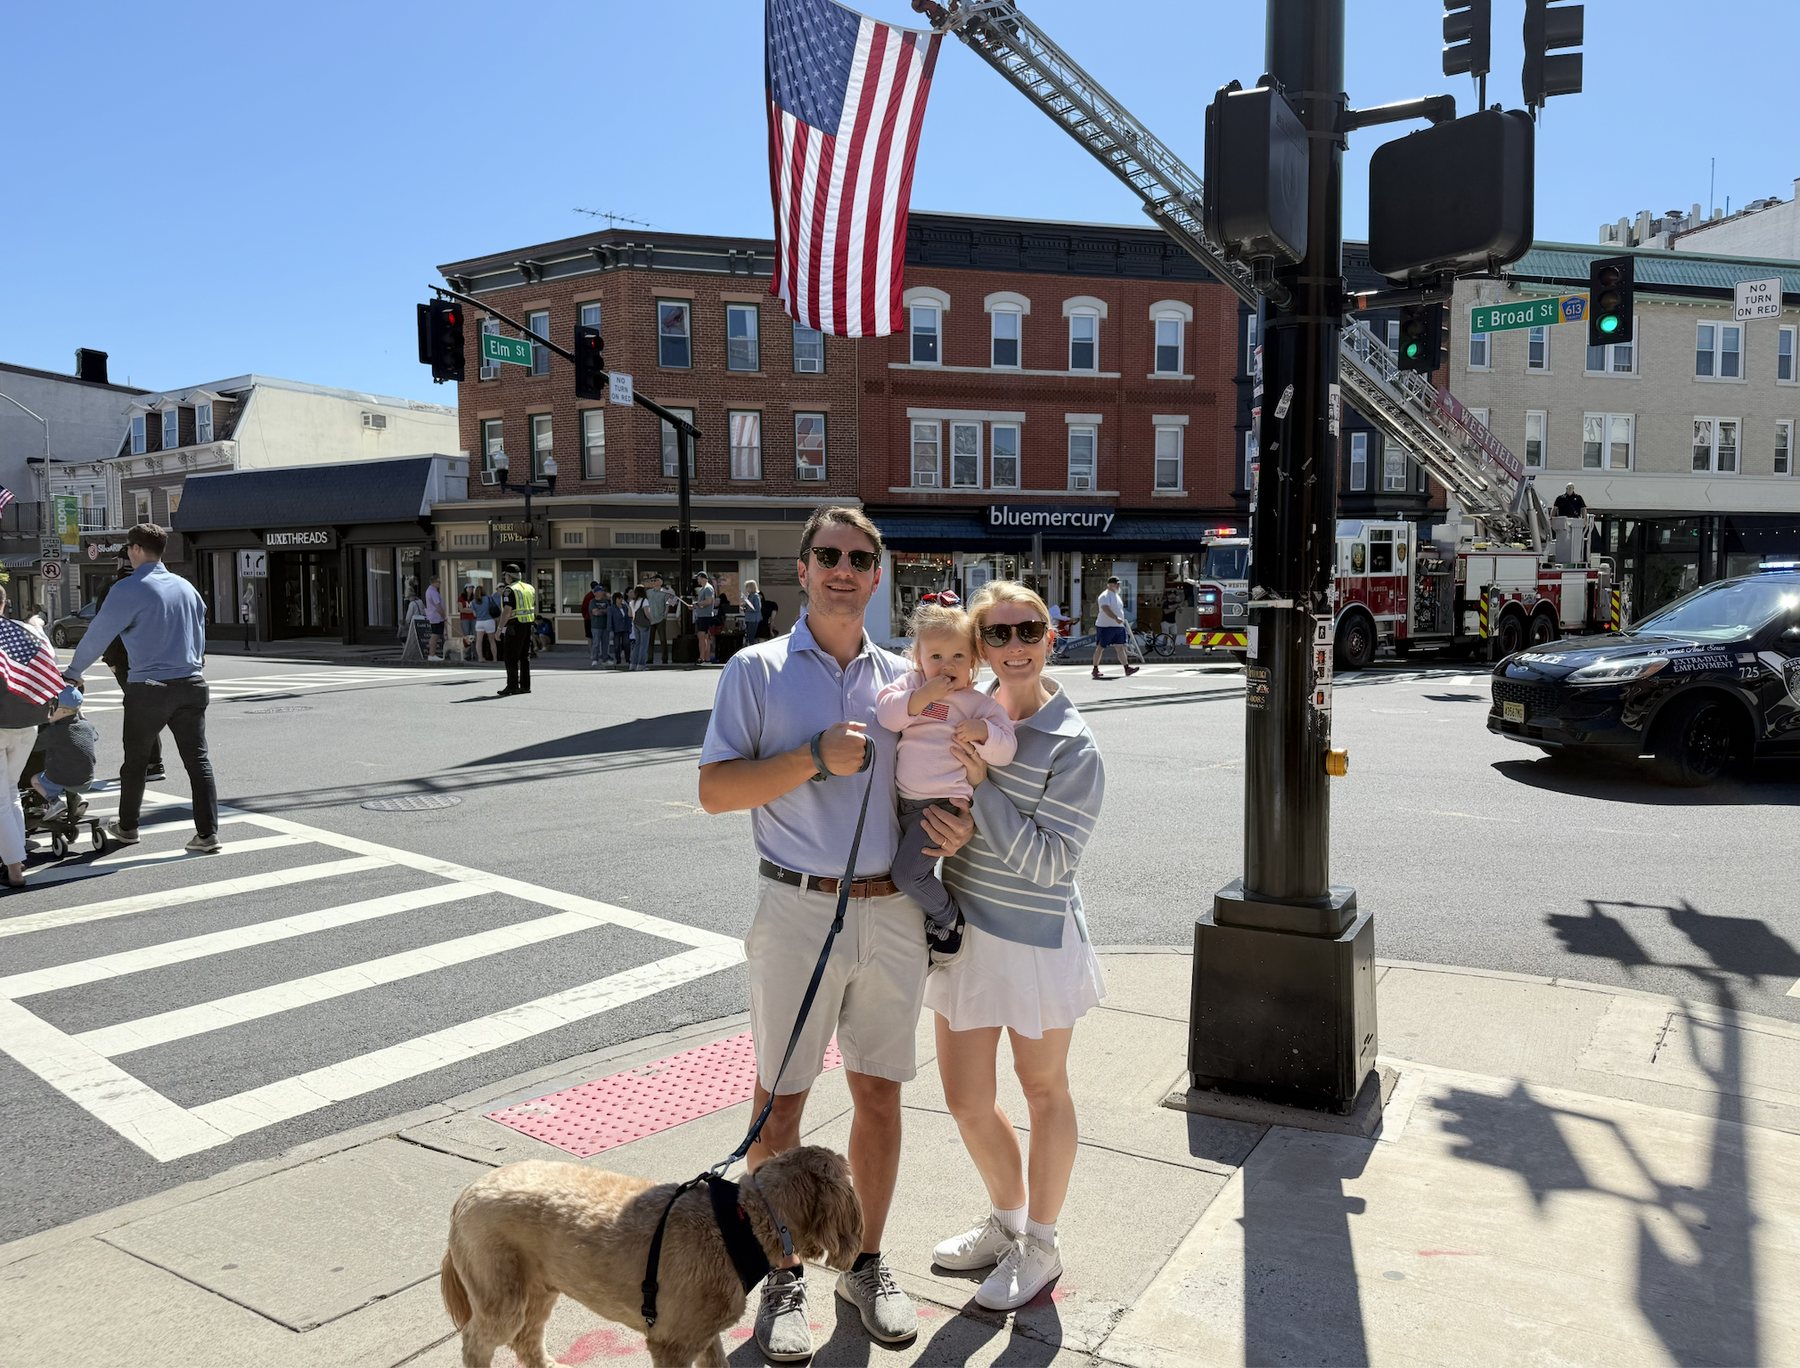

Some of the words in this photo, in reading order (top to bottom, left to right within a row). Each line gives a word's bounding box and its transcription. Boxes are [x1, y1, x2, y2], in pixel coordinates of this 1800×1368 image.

[1750, 283, 1767, 293] NO
[1745, 294, 1772, 304] TURN
[1477, 316, 1484, 328] E
[1491, 307, 1534, 327] Broad
[1540, 304, 1553, 317] St
[1565, 303, 1582, 316] 613
[1737, 307, 1752, 317] ON
[1757, 304, 1778, 315] RED
[490, 340, 510, 358] Elm
[516, 345, 525, 357] St
[614, 384, 629, 393] TURN
[621, 394, 632, 402] RED
[1461, 408, 1519, 473] WESTFIELD
[57, 499, 67, 534] BLOOM
[990, 505, 1115, 533] bluemercury
[266, 531, 328, 546] LUXETHREADS
[42, 549, 60, 558] 25
[1659, 647, 1685, 656] Protect
[1706, 644, 1726, 652] Serve
[1514, 652, 1567, 665] POLICE
[1673, 654, 1729, 666] EXTRA-DUTY
[1673, 660, 1734, 673] EMPLOYMENT
[1738, 666, 1760, 679] 725
